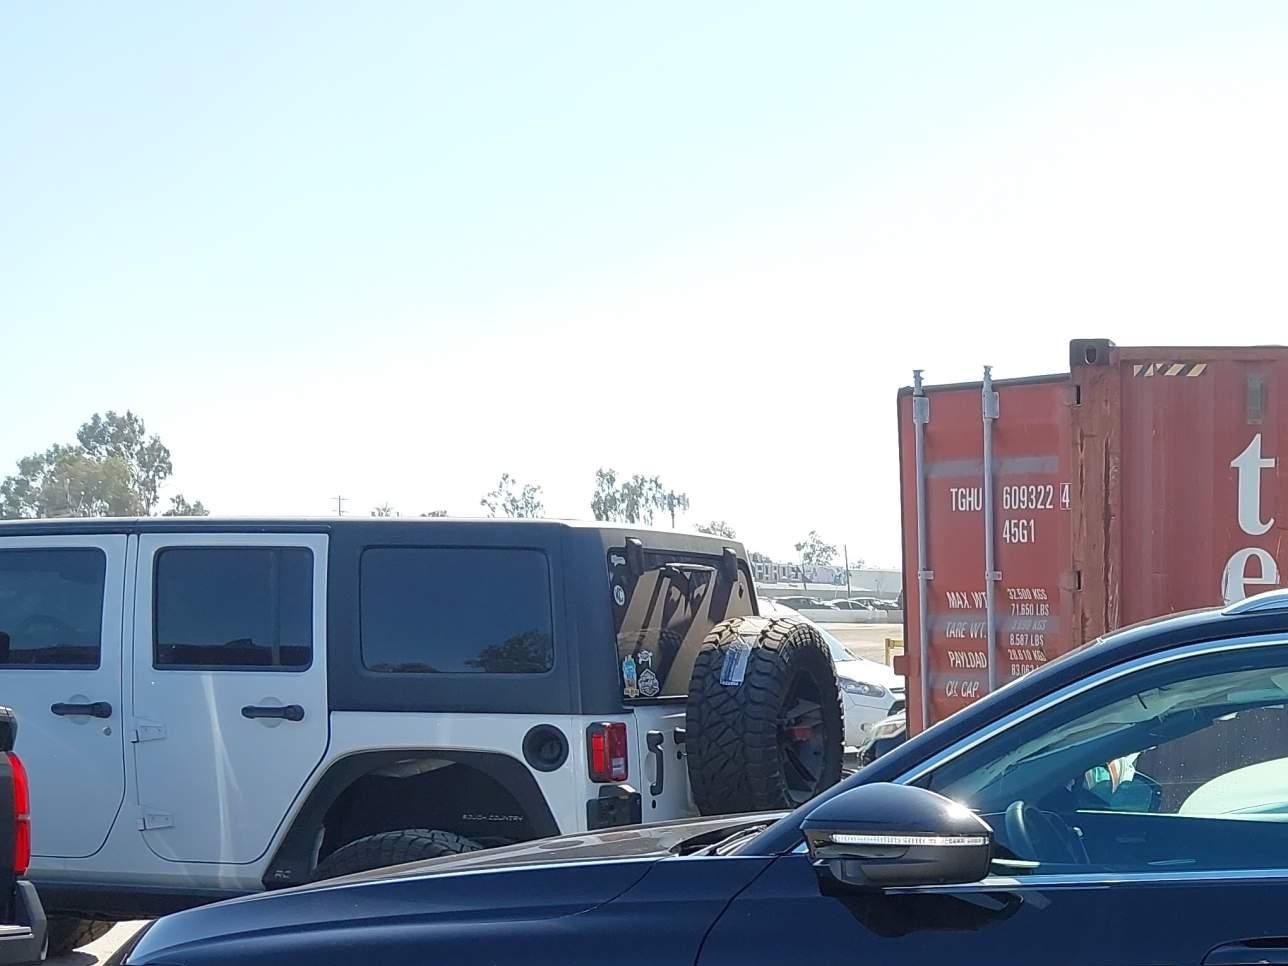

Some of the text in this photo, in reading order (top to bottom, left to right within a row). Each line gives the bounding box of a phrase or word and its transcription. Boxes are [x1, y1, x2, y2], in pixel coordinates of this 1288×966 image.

[950, 483, 1071, 512] TGHU 609322 4
[1002, 519, 1035, 544] 45G1
[946, 592, 972, 609] MAX.
[1035, 603, 1050, 616] LBS
[1030, 633, 1044, 646] LBS
[947, 651, 987, 669] PAYLOAD
